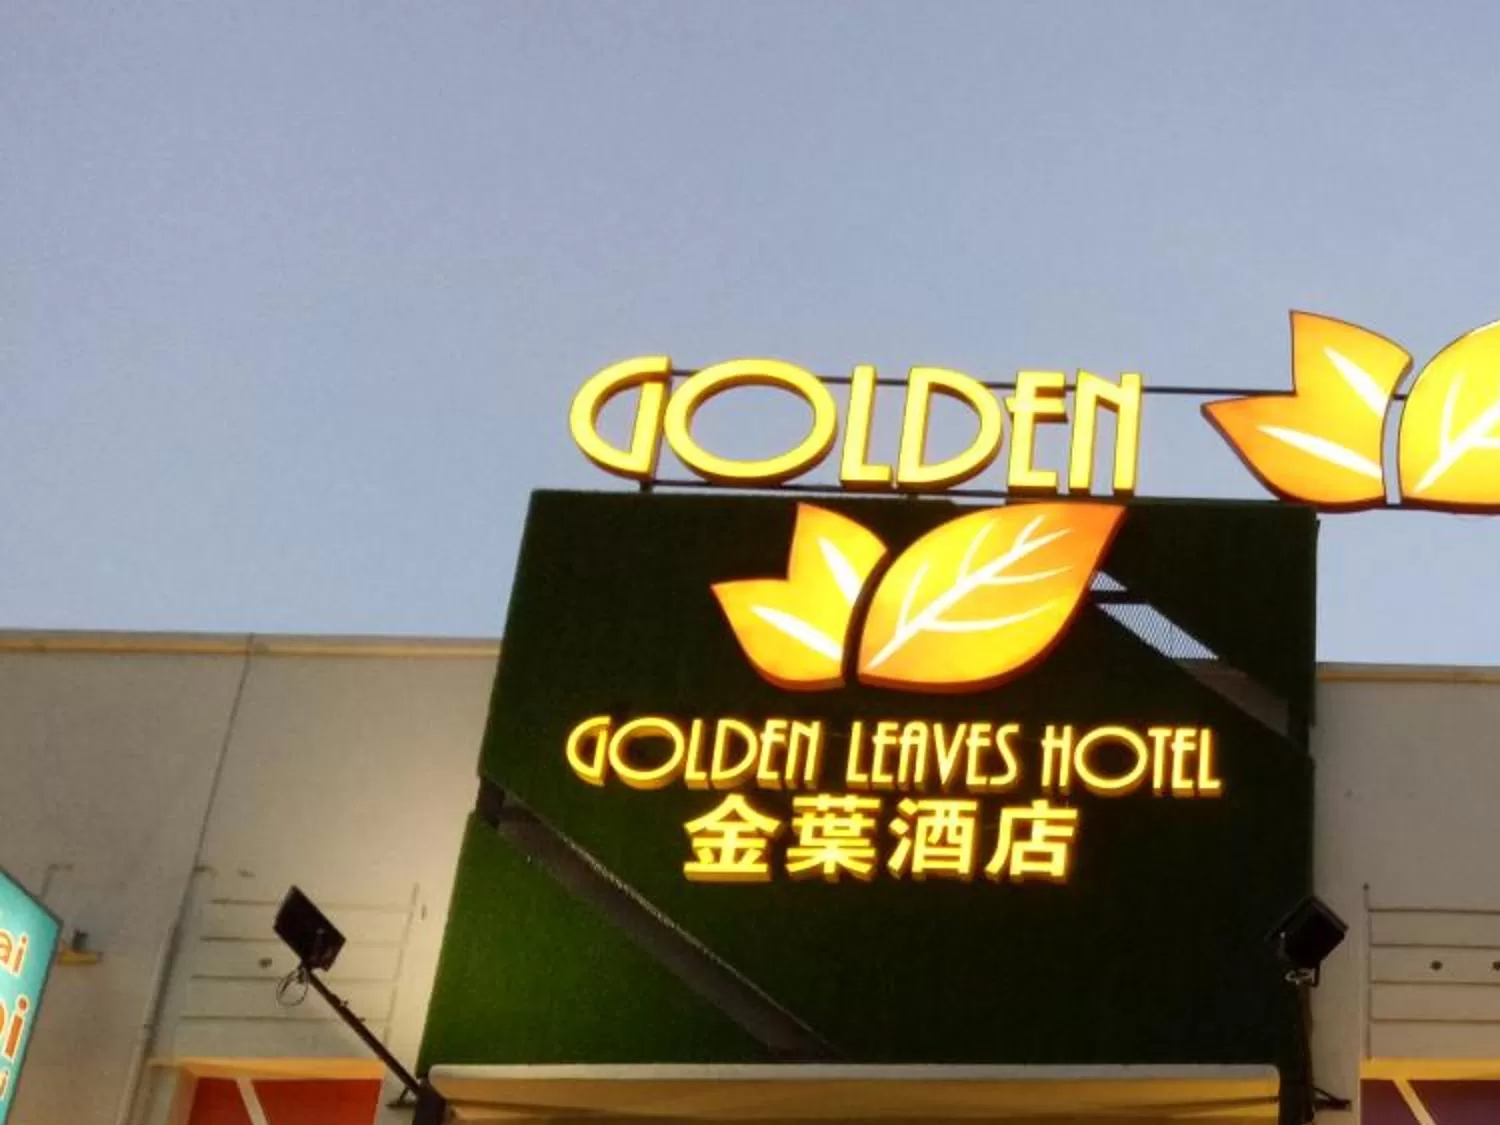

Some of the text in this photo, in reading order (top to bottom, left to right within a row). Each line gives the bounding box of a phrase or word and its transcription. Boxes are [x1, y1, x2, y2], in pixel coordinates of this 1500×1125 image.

[569, 356, 1143, 497] GOLDEN
[566, 715, 1223, 798] GOLDEN LEAVES HOTEL
[683, 792, 1080, 883] 金葉酒店
